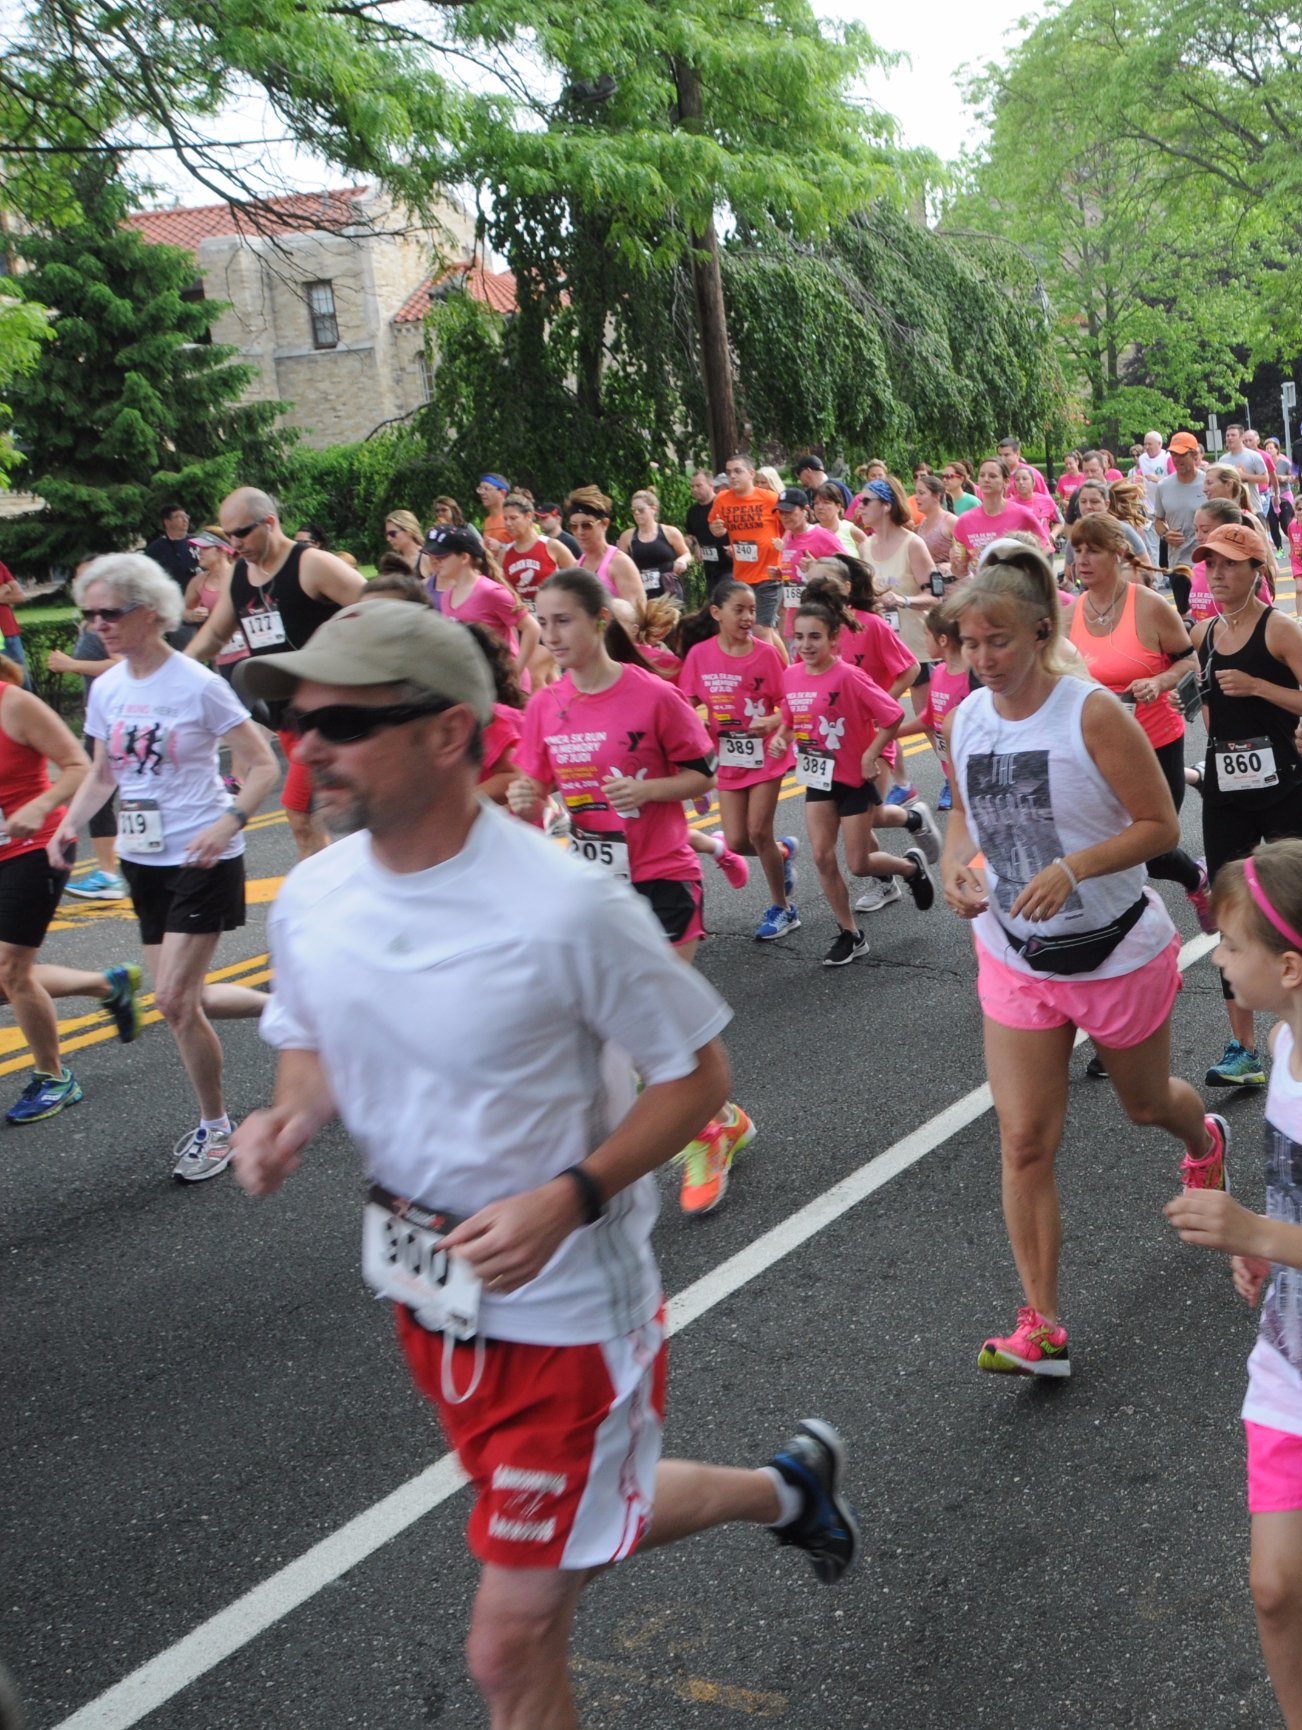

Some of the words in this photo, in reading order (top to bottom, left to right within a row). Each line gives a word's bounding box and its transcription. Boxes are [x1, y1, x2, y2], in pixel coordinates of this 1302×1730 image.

[727, 504, 763, 513] SPEAK
[724, 513, 763, 523] LUENT
[736, 545, 752, 554] 240
[786, 588, 801, 599] 168
[249, 615, 272, 634] 177
[726, 739, 754, 755] 389
[803, 756, 826, 776] 384
[991, 753, 1017, 786] THE
[1223, 752, 1261, 775] 860
[571, 840, 613, 866] 05
